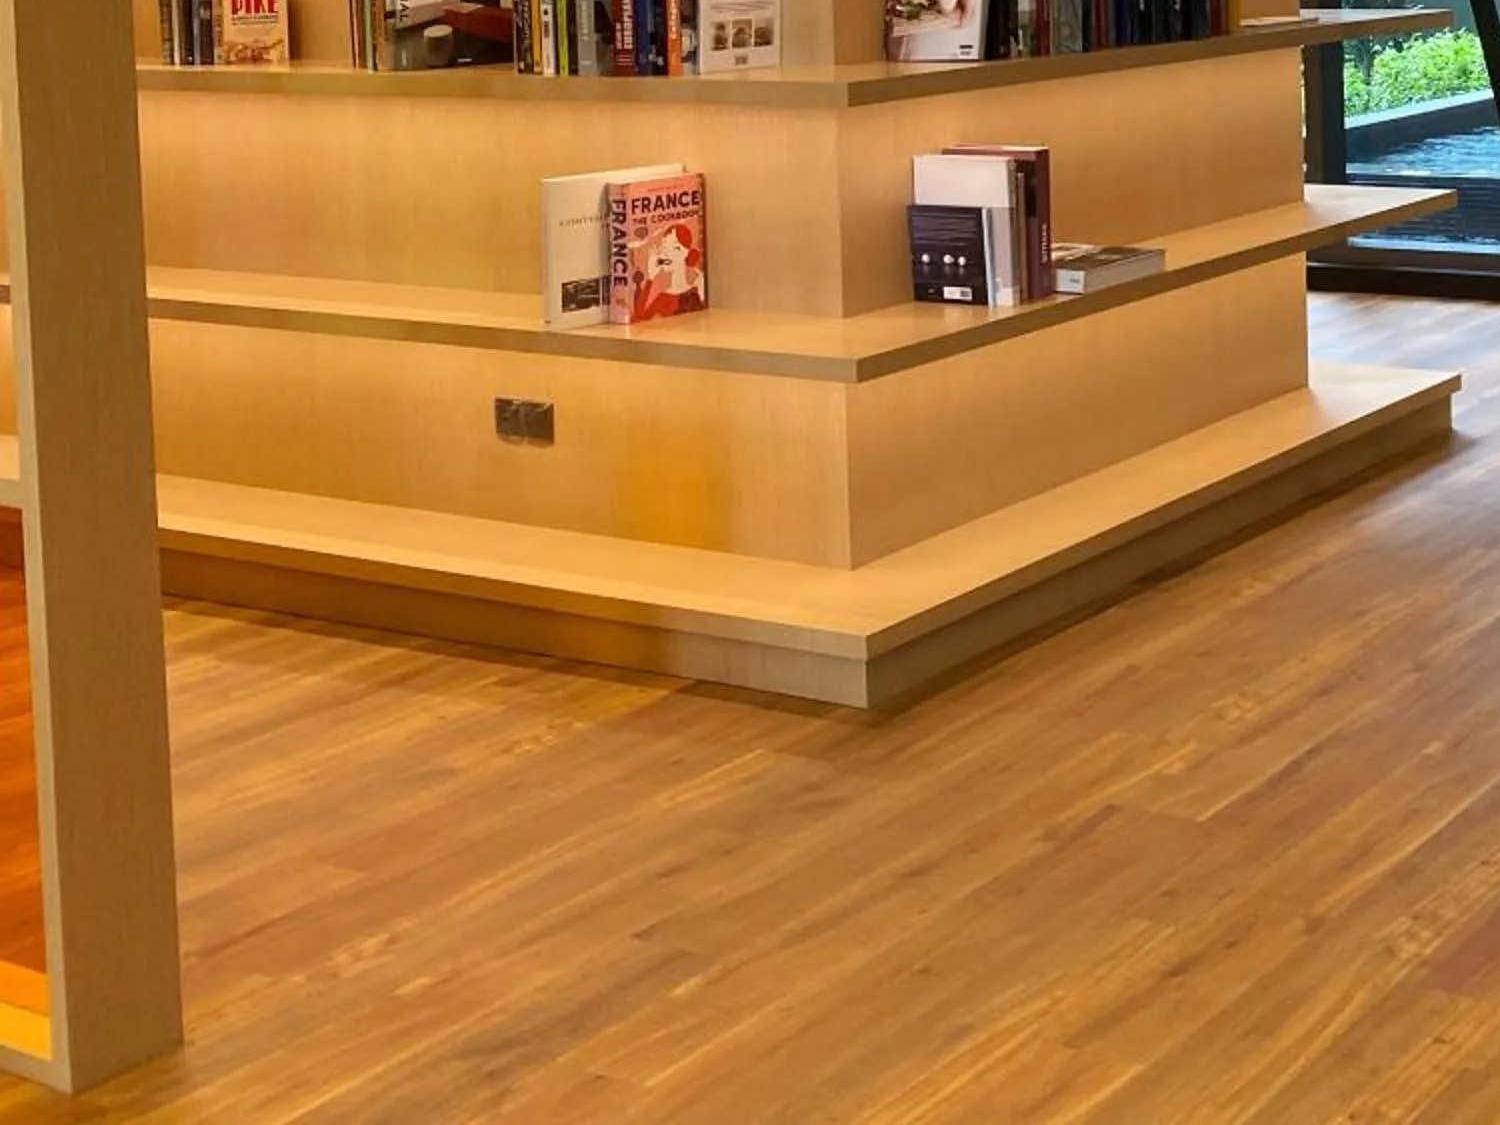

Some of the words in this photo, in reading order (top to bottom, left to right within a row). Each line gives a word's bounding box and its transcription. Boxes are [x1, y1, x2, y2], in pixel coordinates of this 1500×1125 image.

[631, 189, 701, 215] FRANCE
[632, 215, 648, 225] THE
[612, 199, 628, 287] FRANCE
